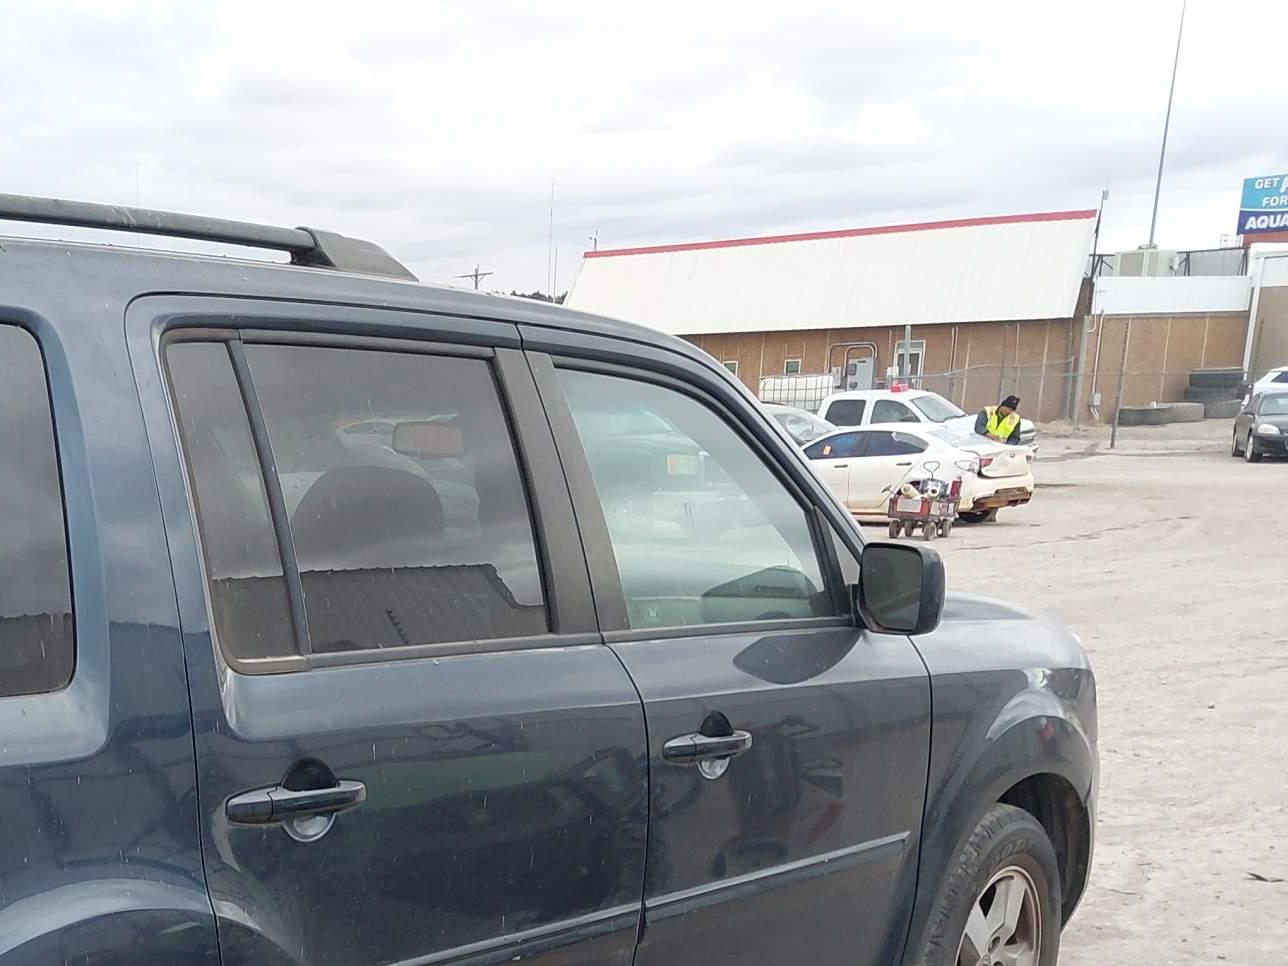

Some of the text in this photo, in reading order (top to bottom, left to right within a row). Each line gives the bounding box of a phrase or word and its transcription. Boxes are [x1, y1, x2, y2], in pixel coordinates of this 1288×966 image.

[1254, 177, 1280, 189] GET
[1262, 195, 1288, 207] FOR
[1244, 214, 1288, 230] AQUA
